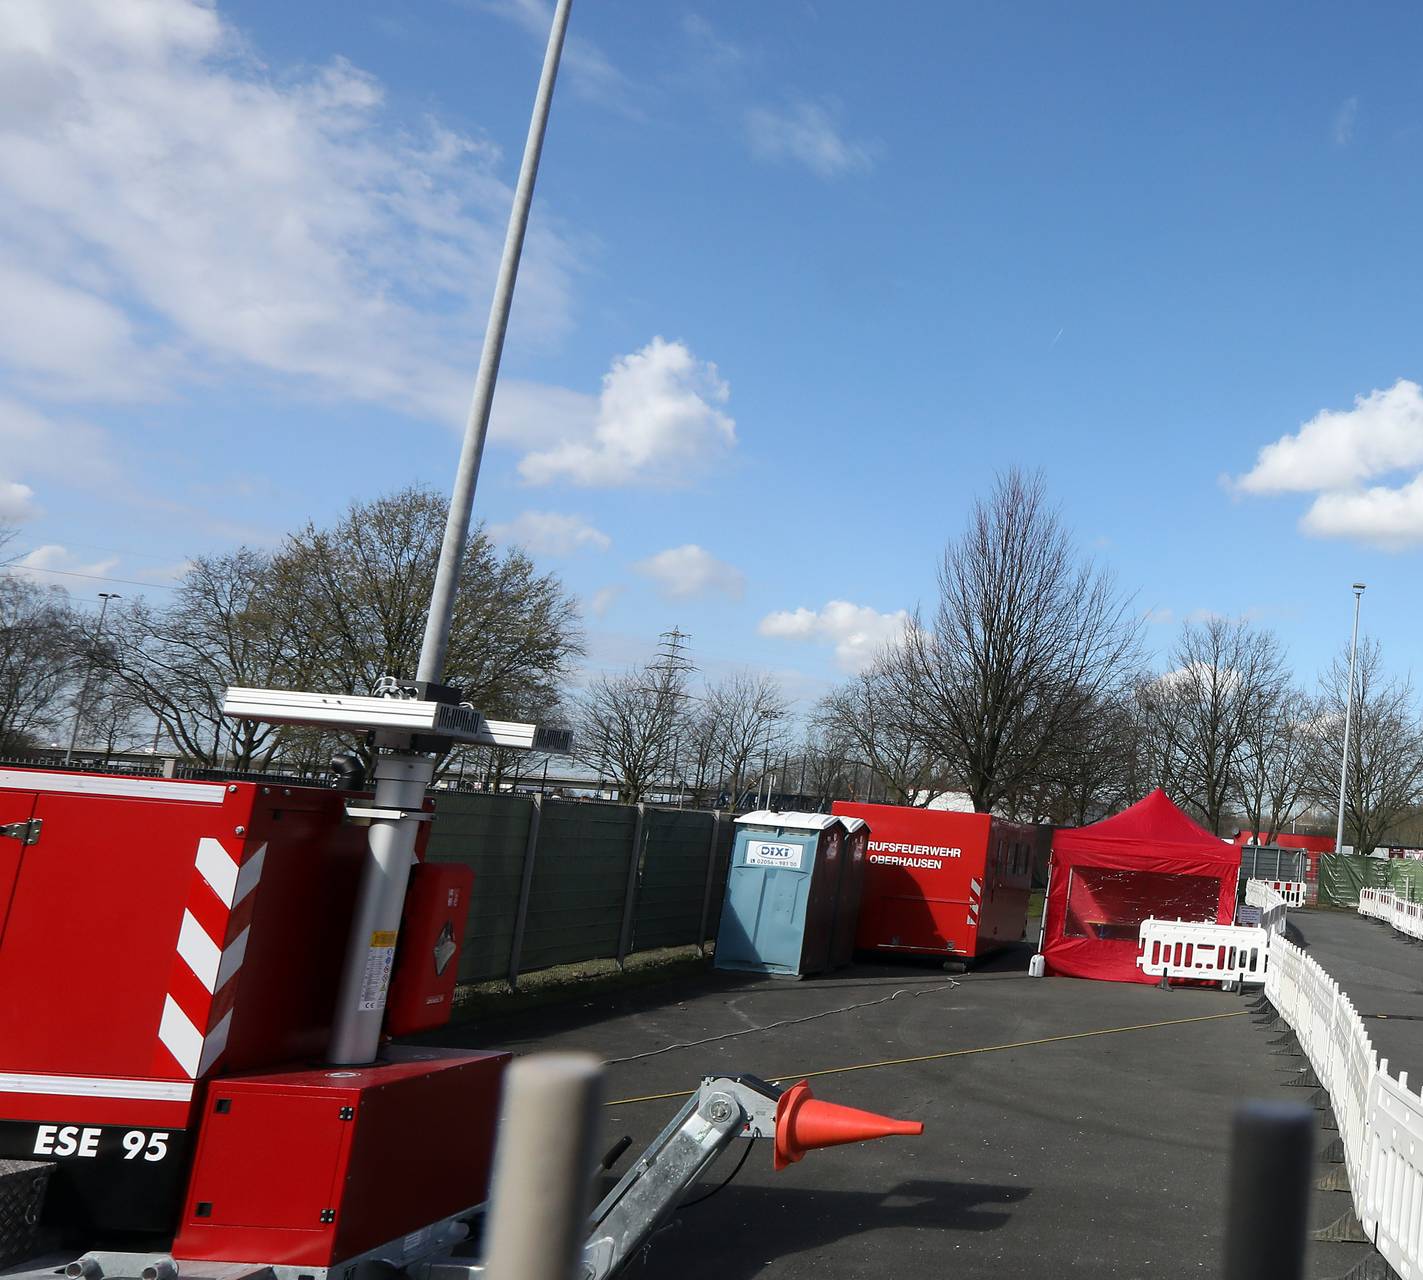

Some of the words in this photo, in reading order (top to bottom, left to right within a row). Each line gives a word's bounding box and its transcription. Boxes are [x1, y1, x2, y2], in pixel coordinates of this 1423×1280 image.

[869, 854, 942, 869] OBERHAUSEN
[33, 1125, 102, 1158] ESE
[122, 1130, 169, 1162] 95
